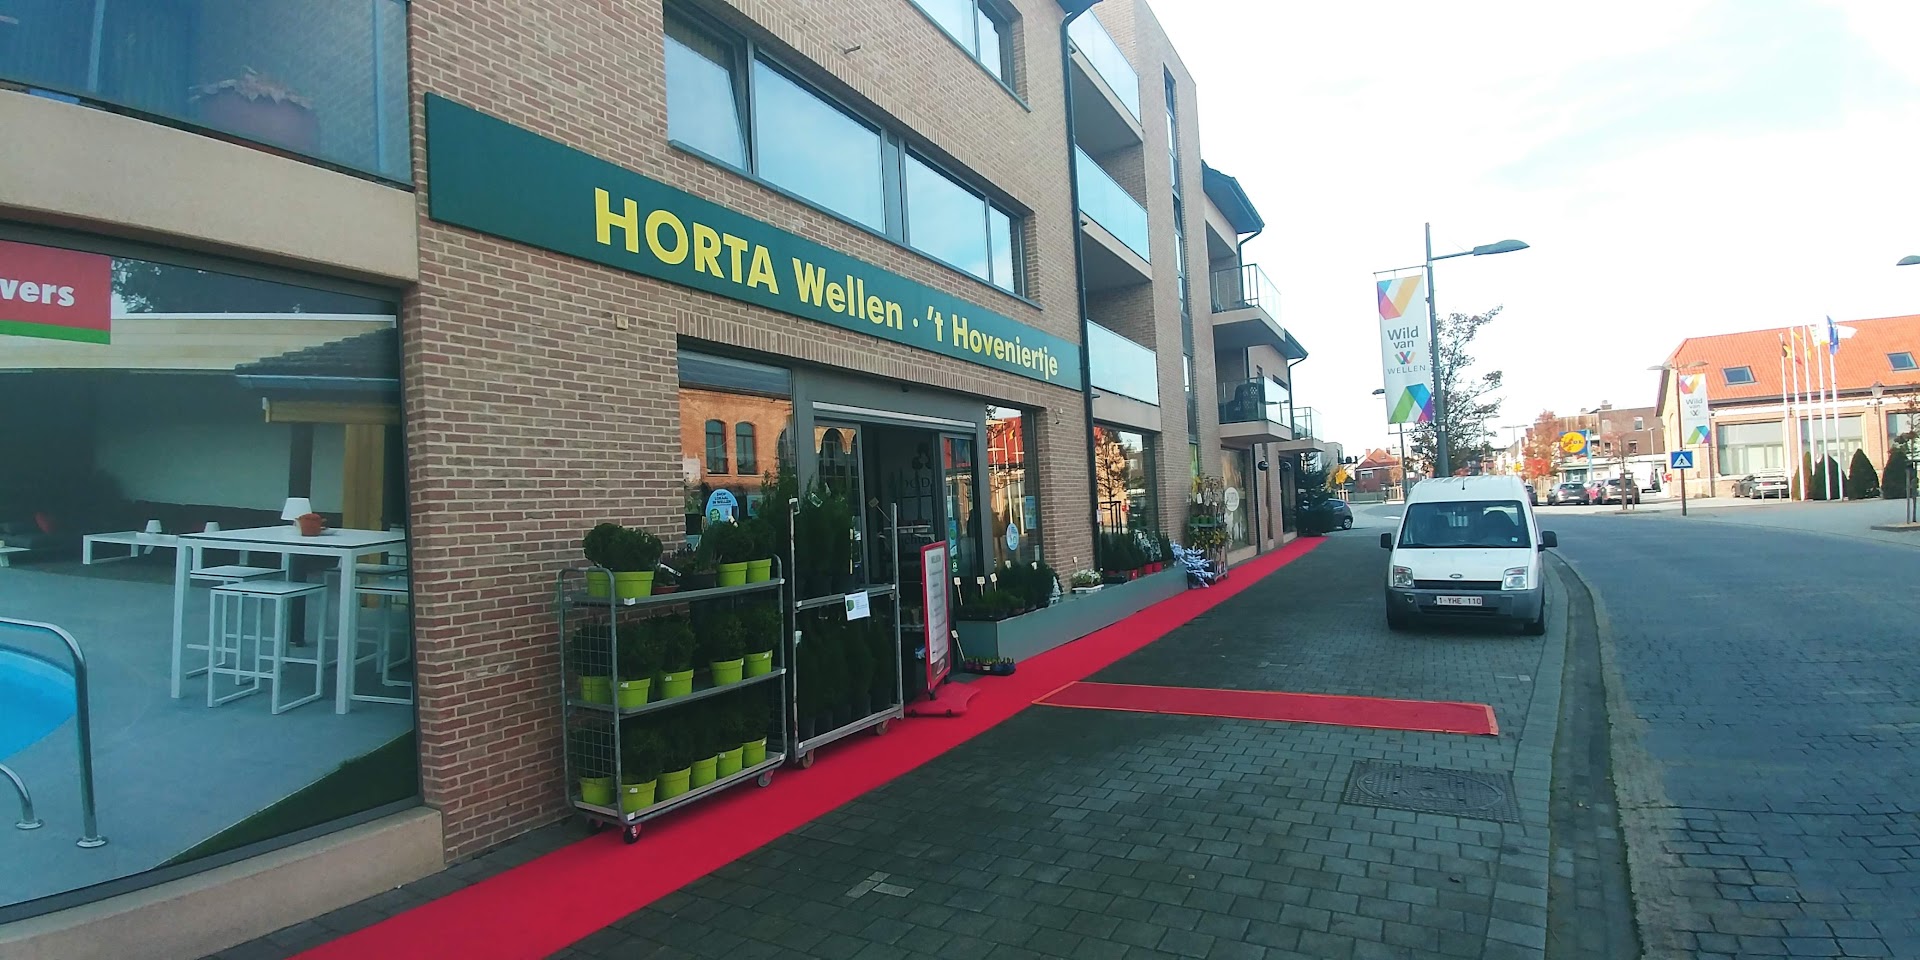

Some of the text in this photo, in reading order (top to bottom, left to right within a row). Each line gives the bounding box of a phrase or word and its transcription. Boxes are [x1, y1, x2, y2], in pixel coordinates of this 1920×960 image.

[594, 187, 779, 295] HORTA
[792, 257, 903, 330] Wellen
[952, 314, 1058, 380] Hoveniertje
[1387, 326, 1419, 341] Wild
[1393, 340, 1414, 349] van
[1387, 365, 1426, 375] WELLEN
